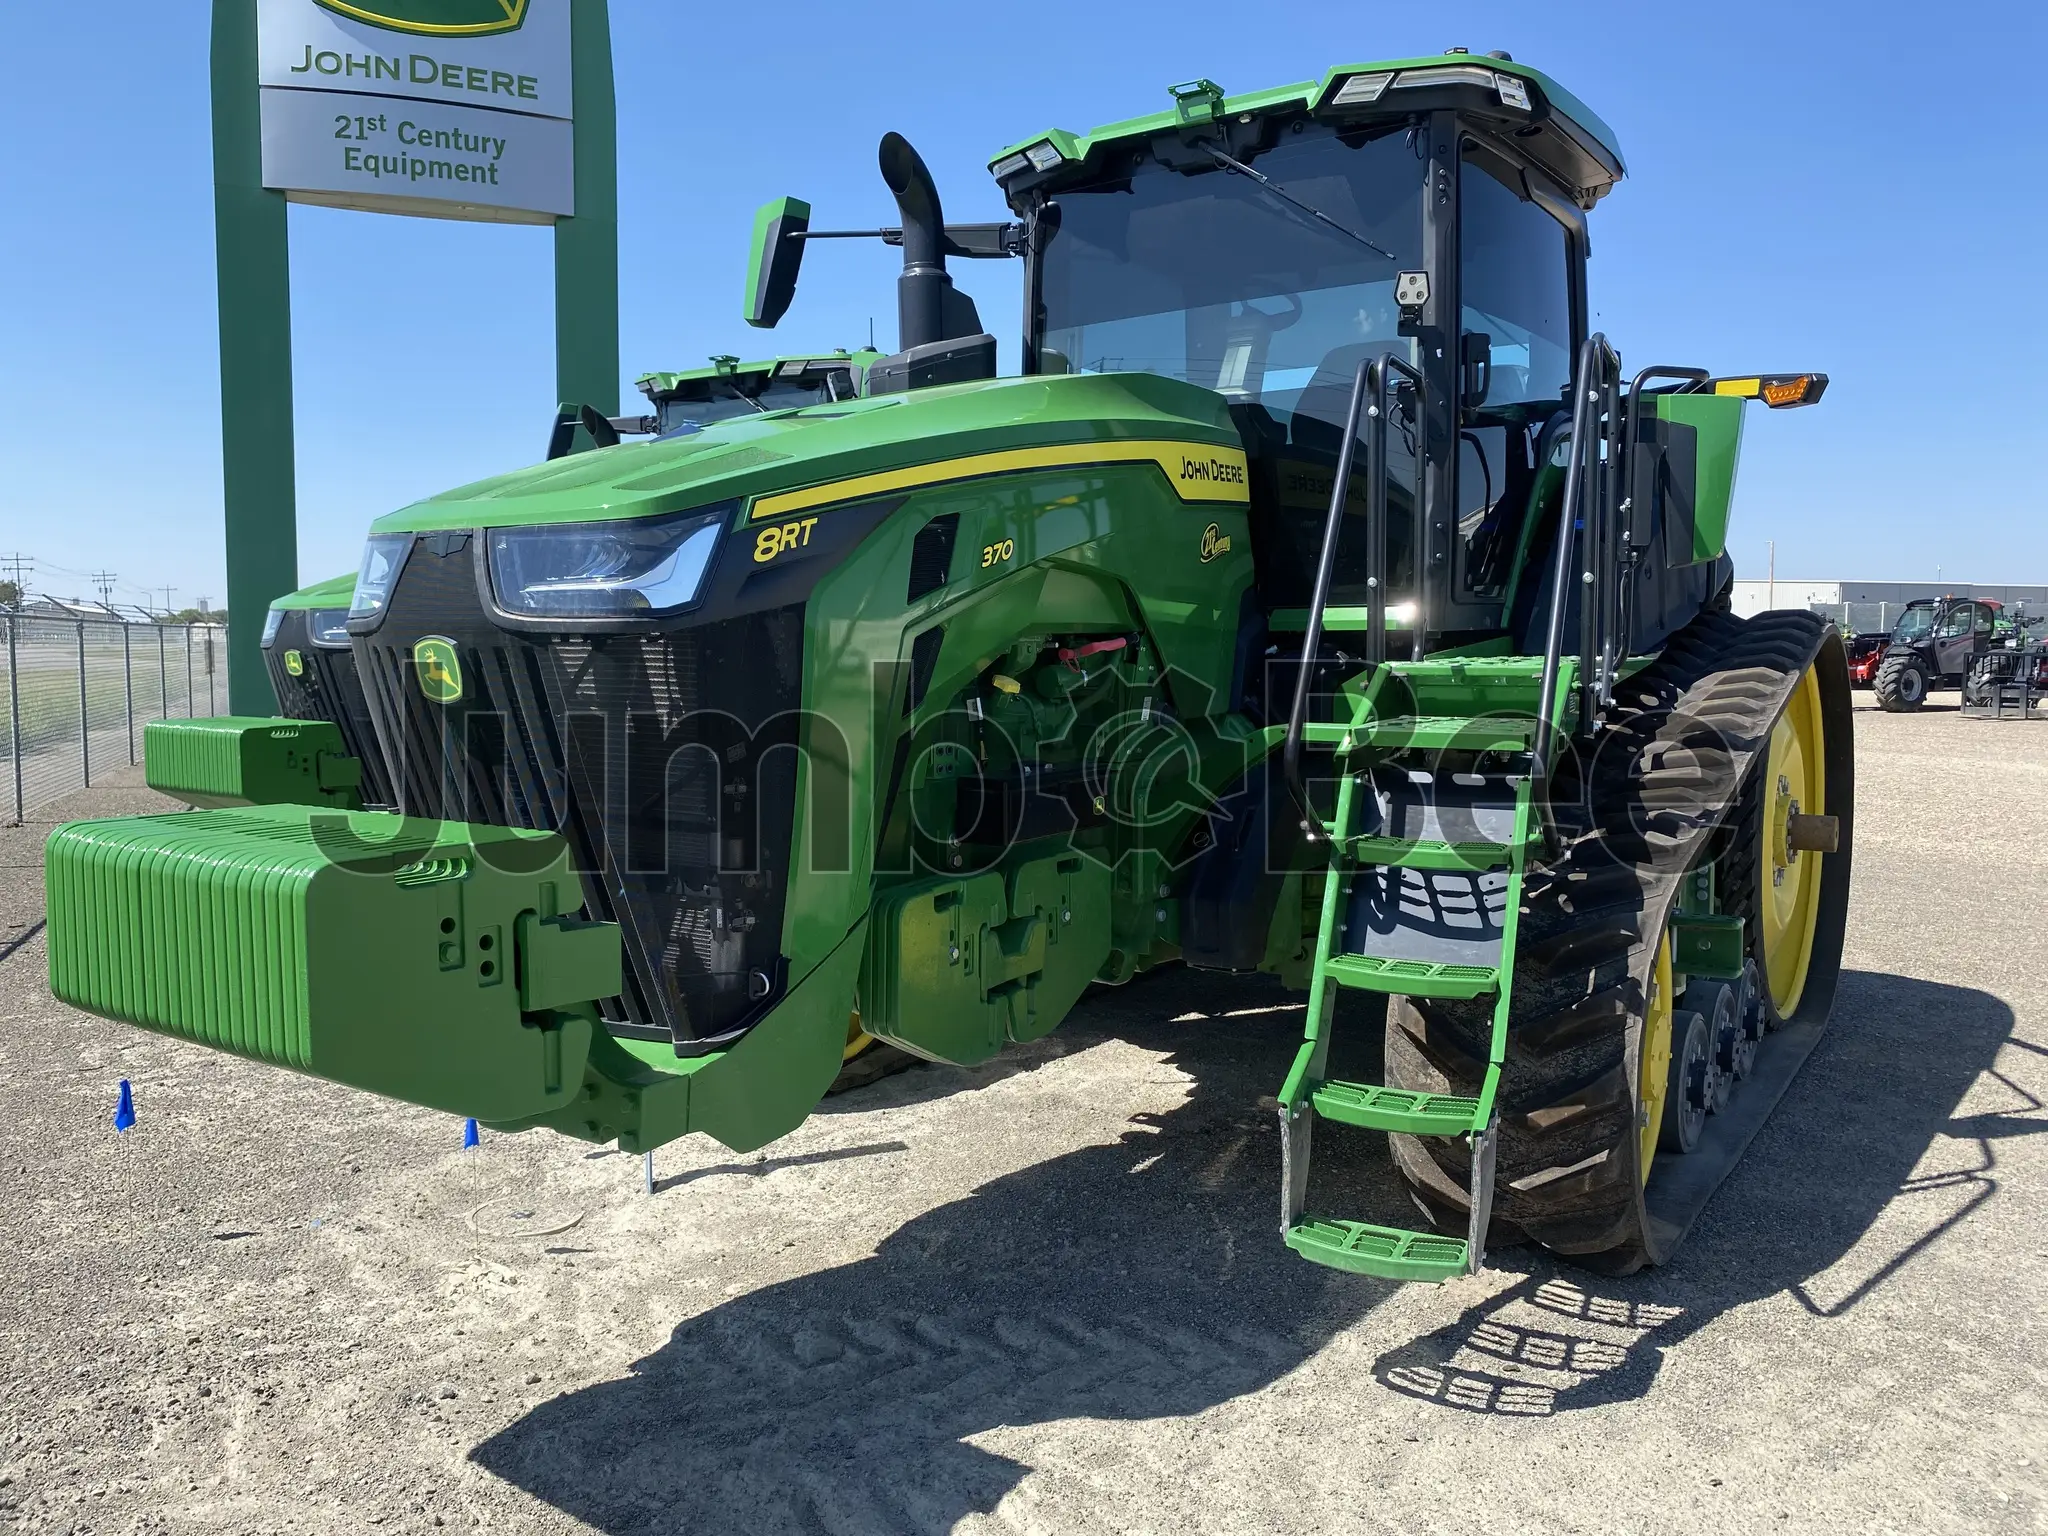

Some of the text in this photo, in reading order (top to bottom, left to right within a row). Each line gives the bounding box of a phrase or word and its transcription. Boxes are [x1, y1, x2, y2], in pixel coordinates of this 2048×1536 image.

[290, 44, 539, 100] JOHN DEERE
[334, 113, 507, 160] 21st Century
[344, 146, 499, 186] Equipment
[1180, 455, 1244, 484] JOHN DEERE
[753, 517, 818, 563] 8RT
[981, 538, 1014, 568] 370
